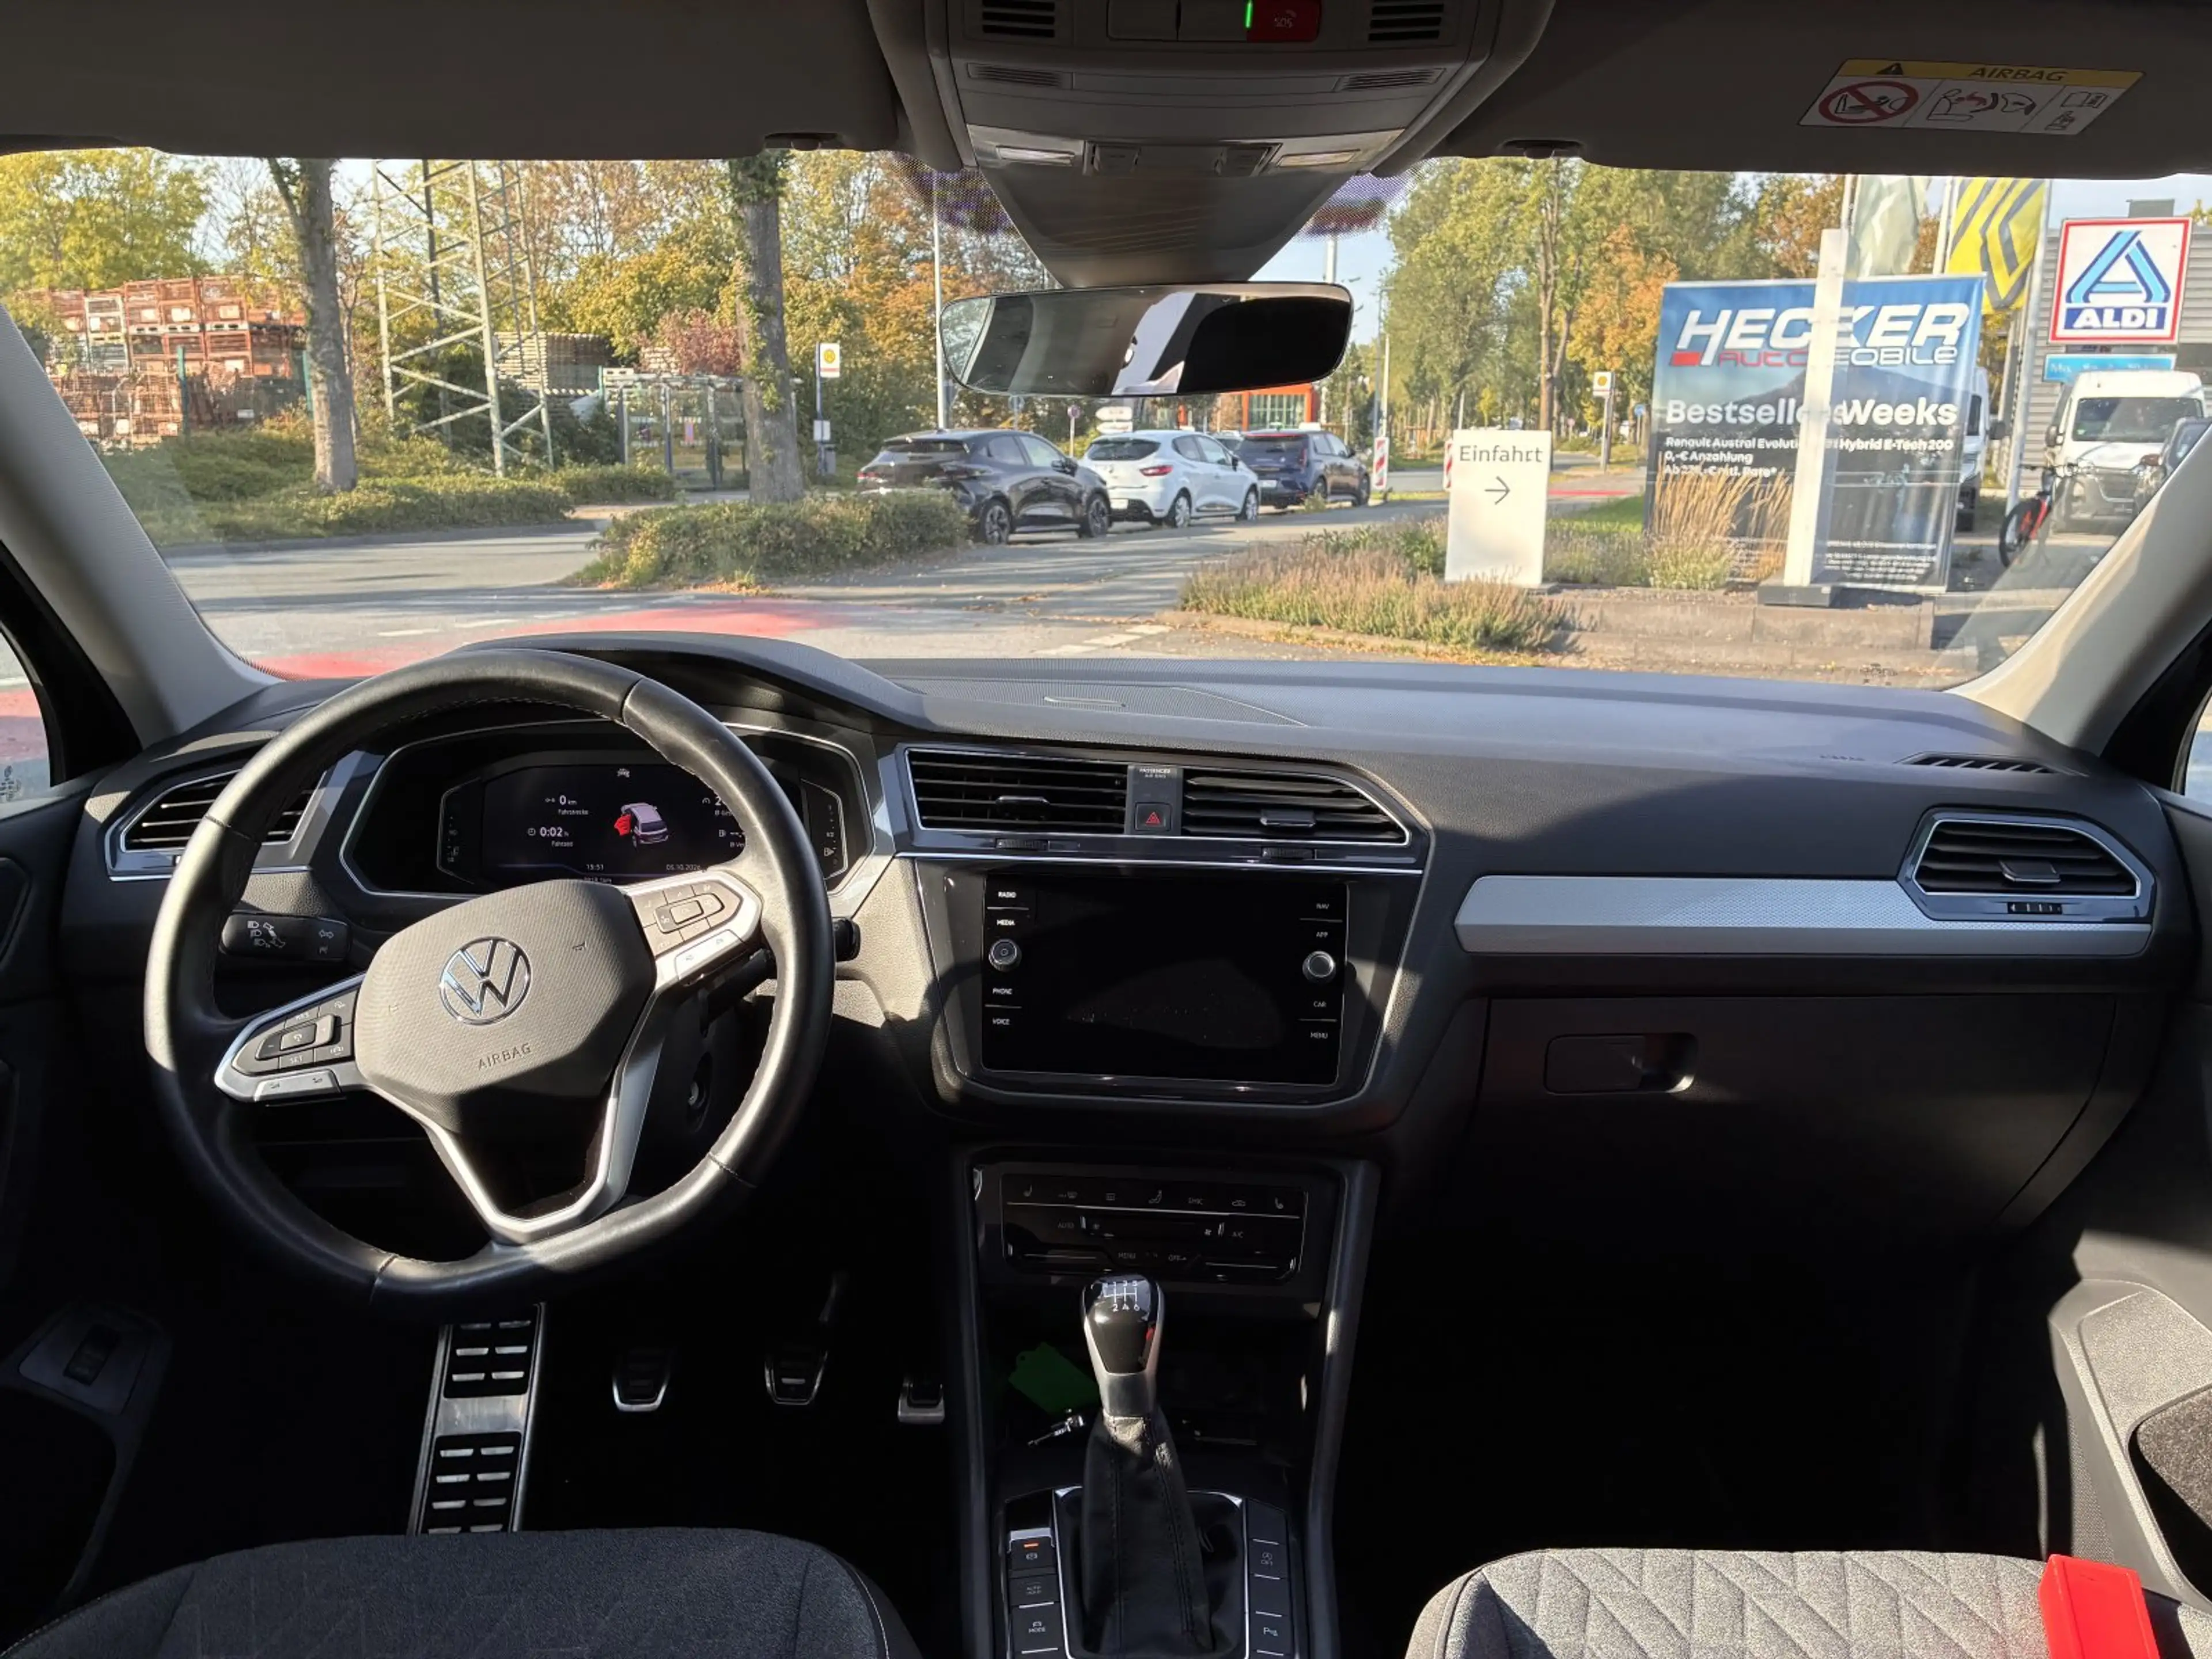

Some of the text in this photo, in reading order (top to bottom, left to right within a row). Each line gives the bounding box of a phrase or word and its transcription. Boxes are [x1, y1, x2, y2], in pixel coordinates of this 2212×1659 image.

[1968, 67, 2069, 81] AIRBAG
[2072, 308, 2159, 328] ALDI
[1718, 347, 1959, 368] AUTOOBILE
[1666, 397, 1957, 426] Bestsell Weeks
[1459, 445, 1543, 463] Einfahrt
[1665, 437, 1710, 448] Renault
[1712, 437, 1756, 448] Austral
[1839, 438, 1883, 453] Hybrid
[1928, 439, 1955, 450] 200
[1689, 452, 1753, 465] Anzahlung
[539, 826, 563, 838] 0:02
[478, 1042, 531, 1071] AIRBAG
